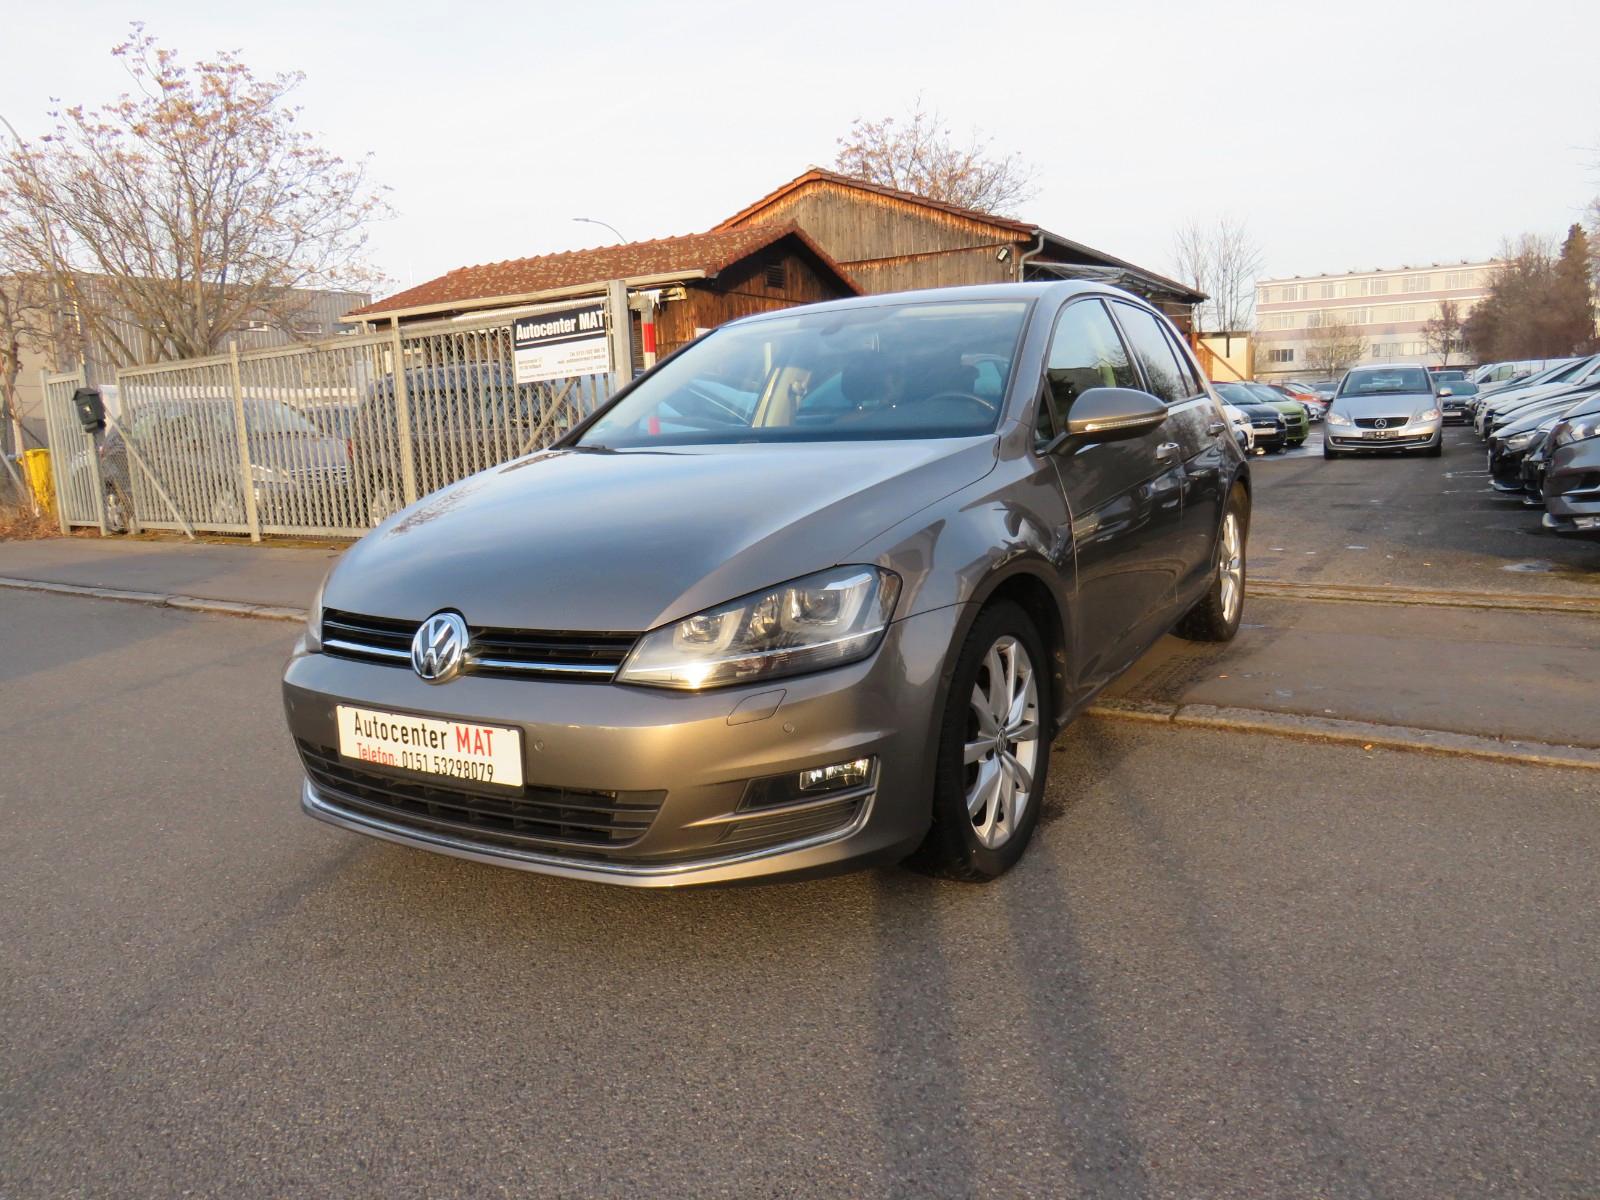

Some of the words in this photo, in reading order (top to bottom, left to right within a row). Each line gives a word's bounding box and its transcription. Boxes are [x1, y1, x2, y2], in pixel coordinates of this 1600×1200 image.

[516, 318, 576, 340] Autocenter
[579, 310, 604, 330] MAT
[354, 711, 448, 750] Autocenter
[455, 726, 493, 757] MAT
[356, 742, 399, 767] Telefon:
[401, 751, 429, 773] 0151
[433, 755, 494, 782] 53298079
